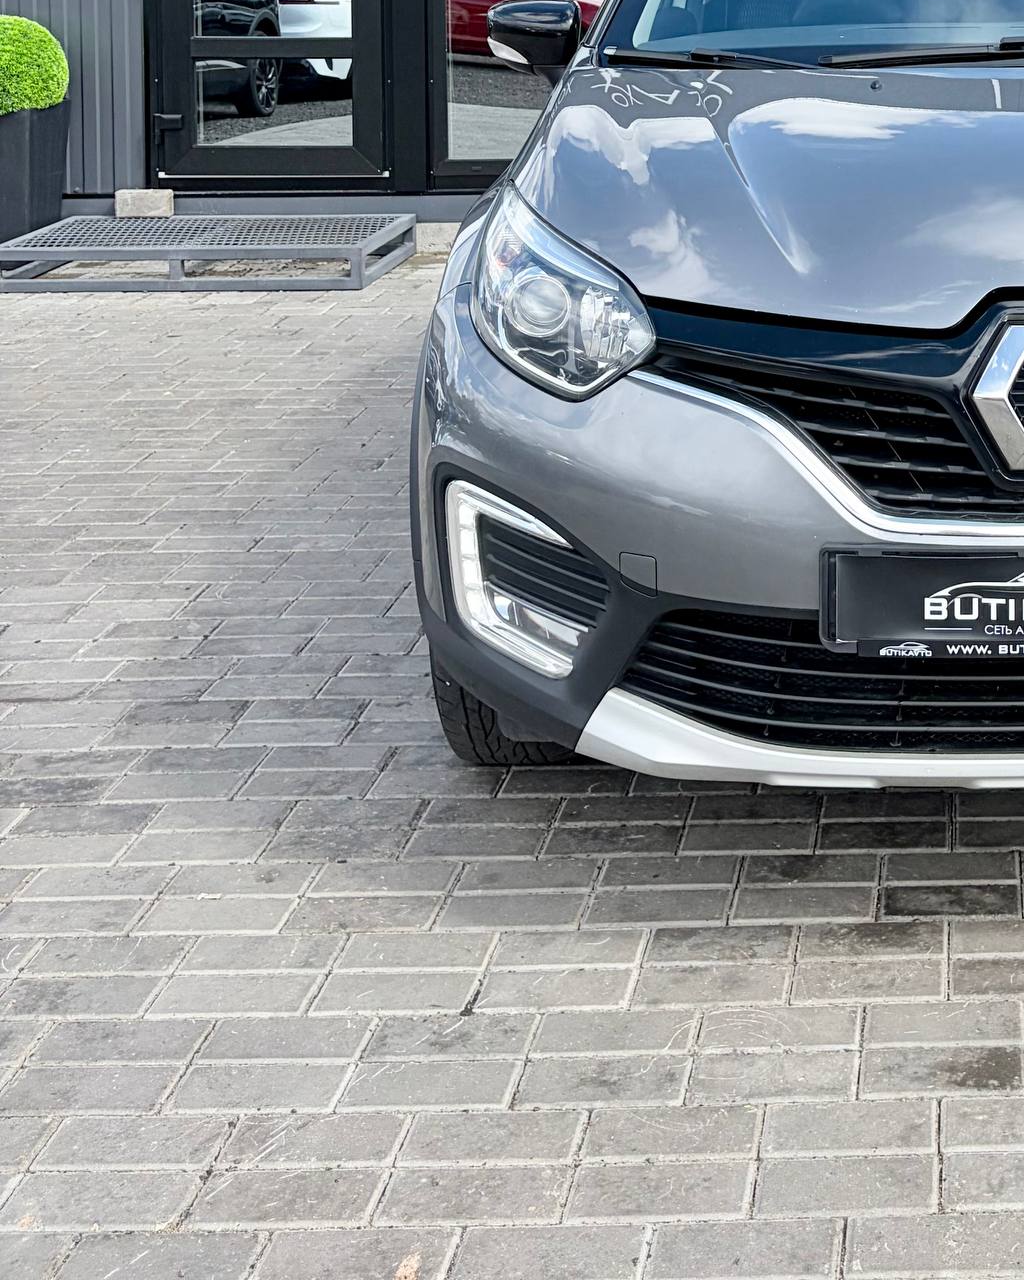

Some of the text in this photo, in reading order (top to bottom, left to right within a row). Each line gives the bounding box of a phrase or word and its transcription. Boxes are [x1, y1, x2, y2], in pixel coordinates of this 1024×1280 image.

[984, 624, 1012, 636] СЕТЬ
[879, 649, 933, 657] BUTIKAVTO
[946, 644, 992, 655] WWW.
